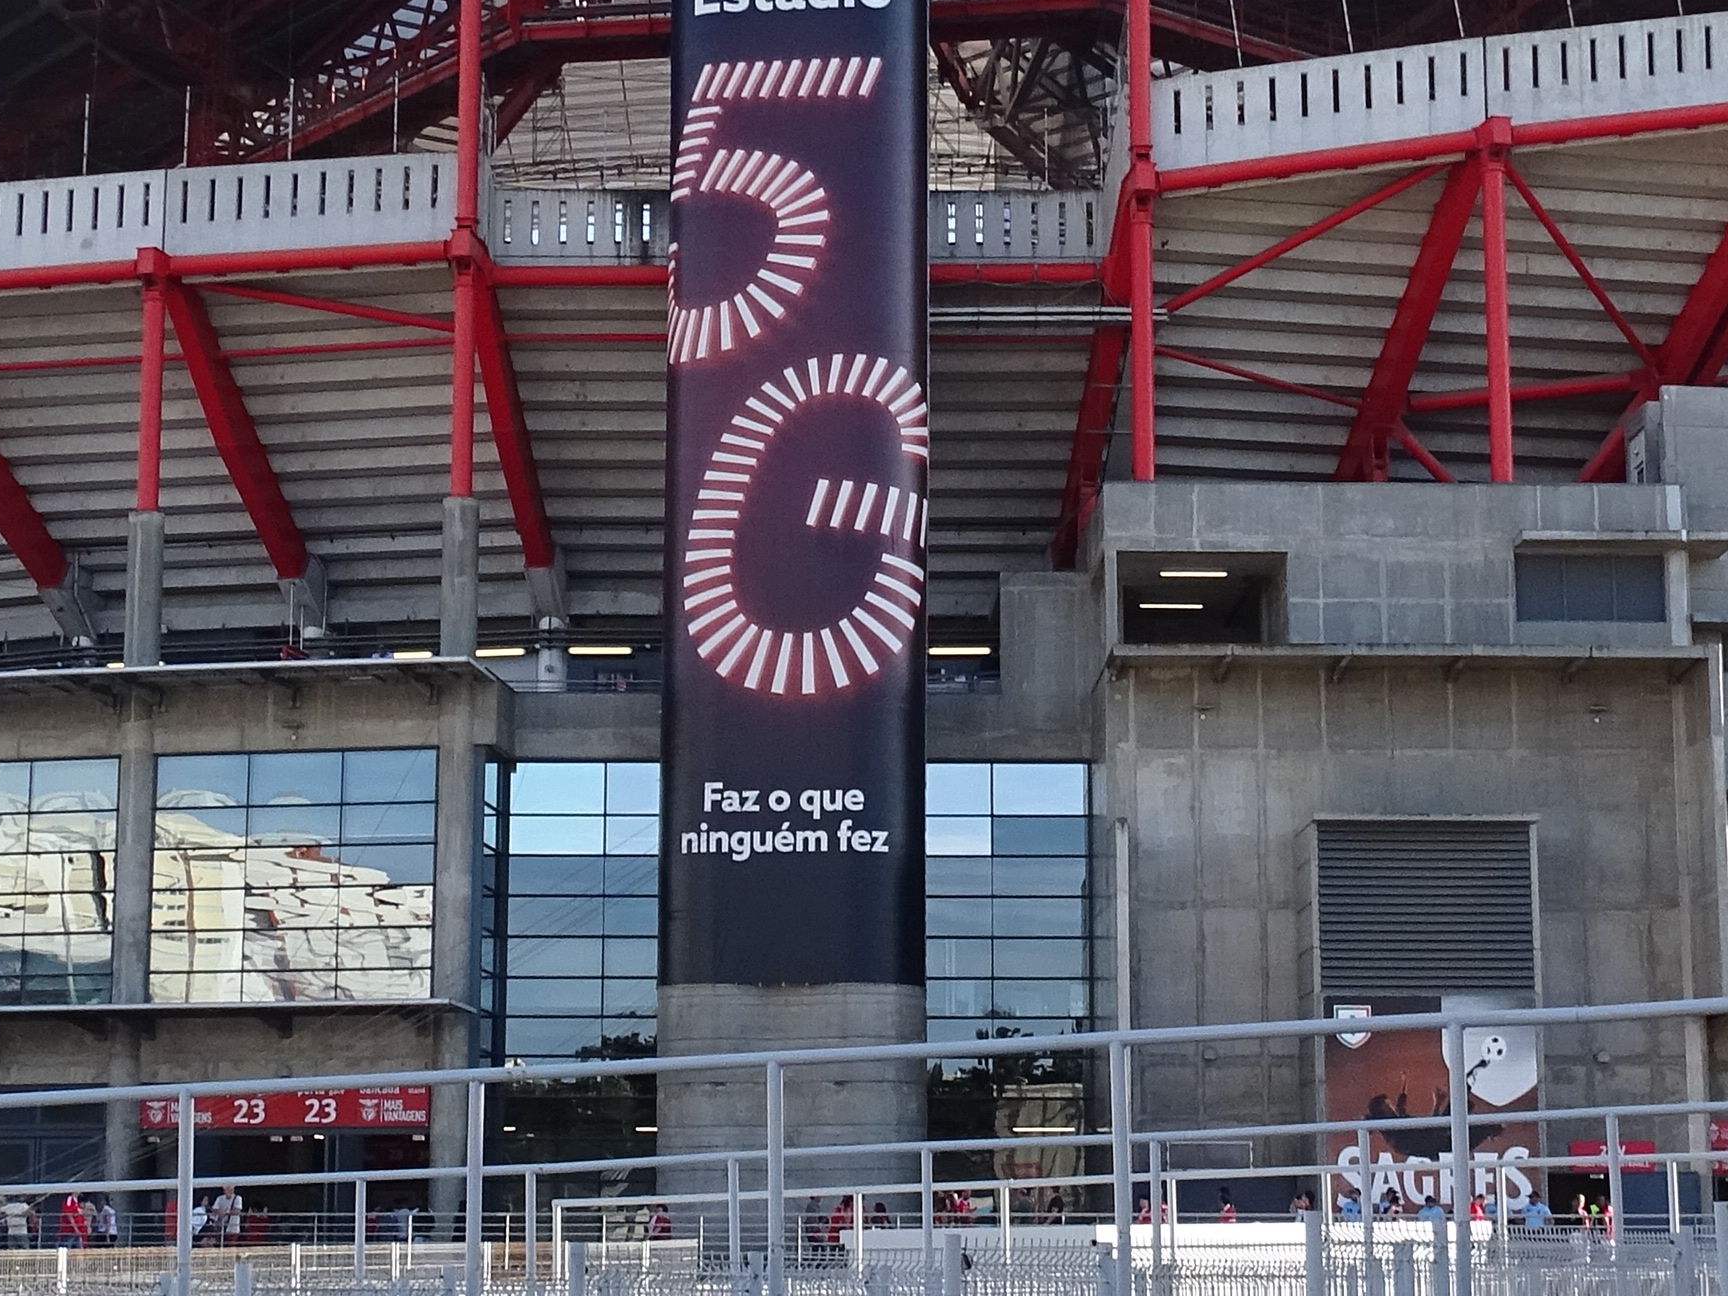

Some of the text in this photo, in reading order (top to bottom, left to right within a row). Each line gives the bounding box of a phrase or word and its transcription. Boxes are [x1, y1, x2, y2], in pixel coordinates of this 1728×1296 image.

[703, 782, 865, 820] Faz o que
[681, 819, 889, 862] ninguém fez
[233, 1099, 265, 1124] 23
[304, 1098, 337, 1123] 23
